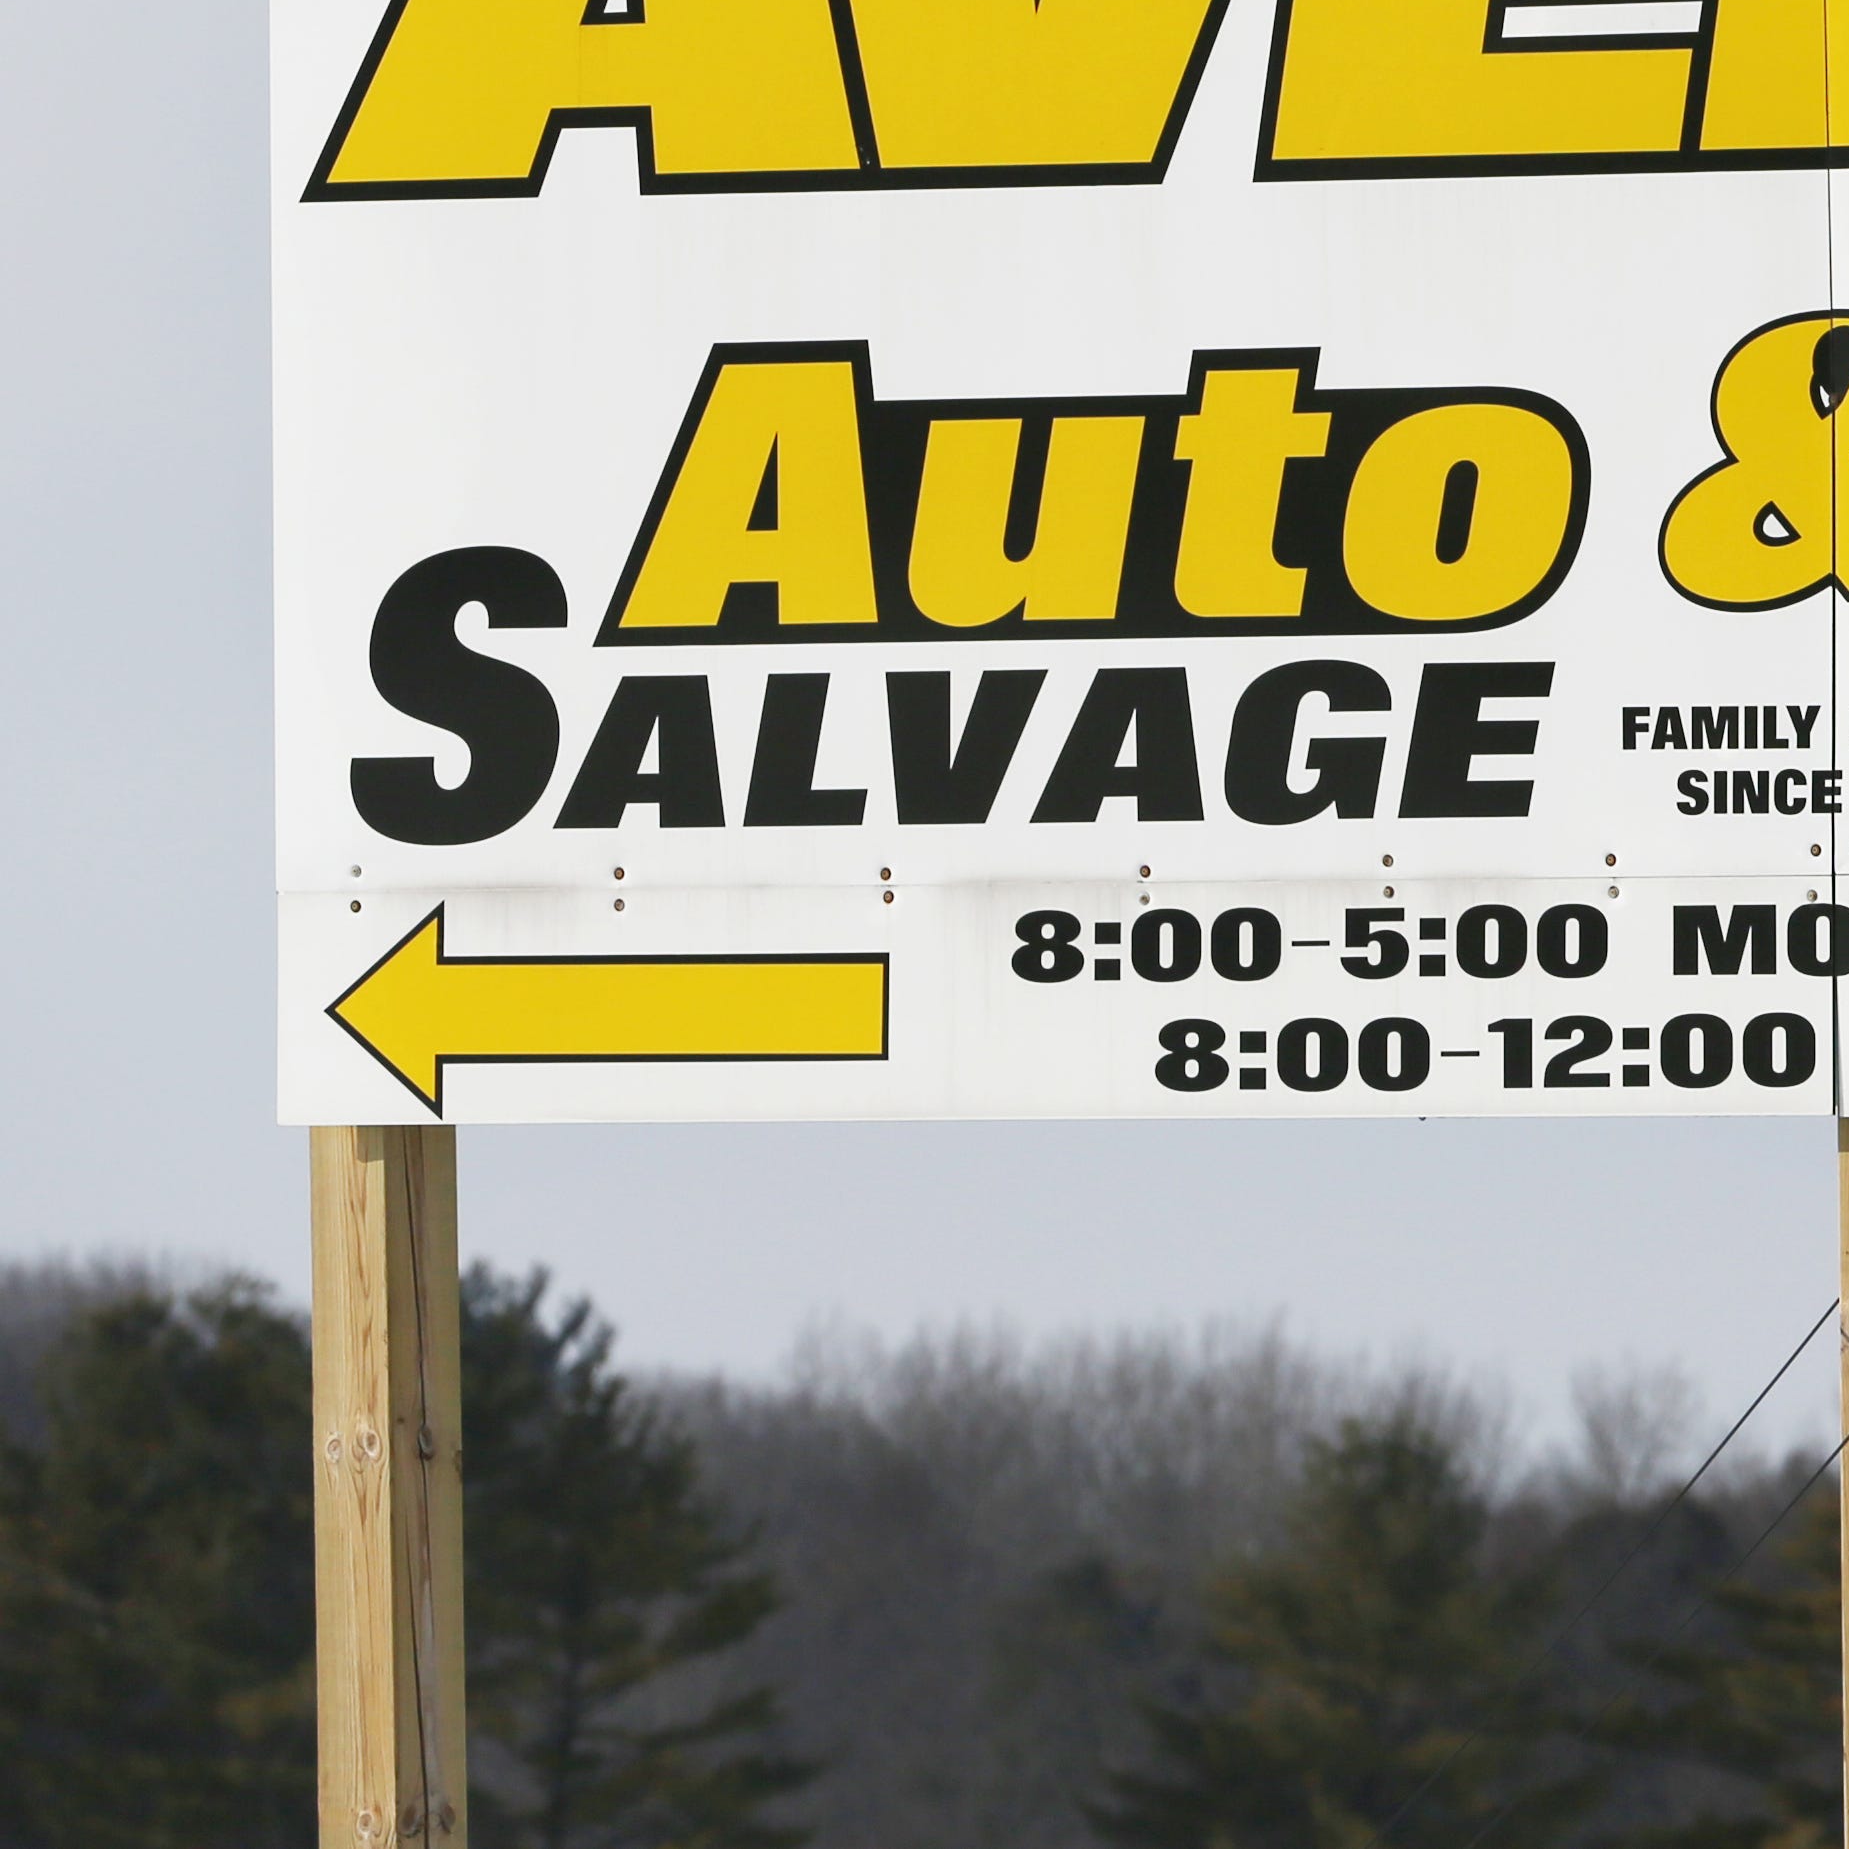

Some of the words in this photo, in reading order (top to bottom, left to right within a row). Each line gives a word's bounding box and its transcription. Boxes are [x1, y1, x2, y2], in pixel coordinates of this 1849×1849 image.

[605, 346, 1585, 641] Auto
[350, 546, 1554, 847] SALVAGE
[1620, 704, 1822, 751] FAMILY
[1675, 767, 1844, 817] SINCE
[1010, 902, 1610, 985] 8:00-5:00
[1153, 1011, 1817, 1094] 8:00-12:00
